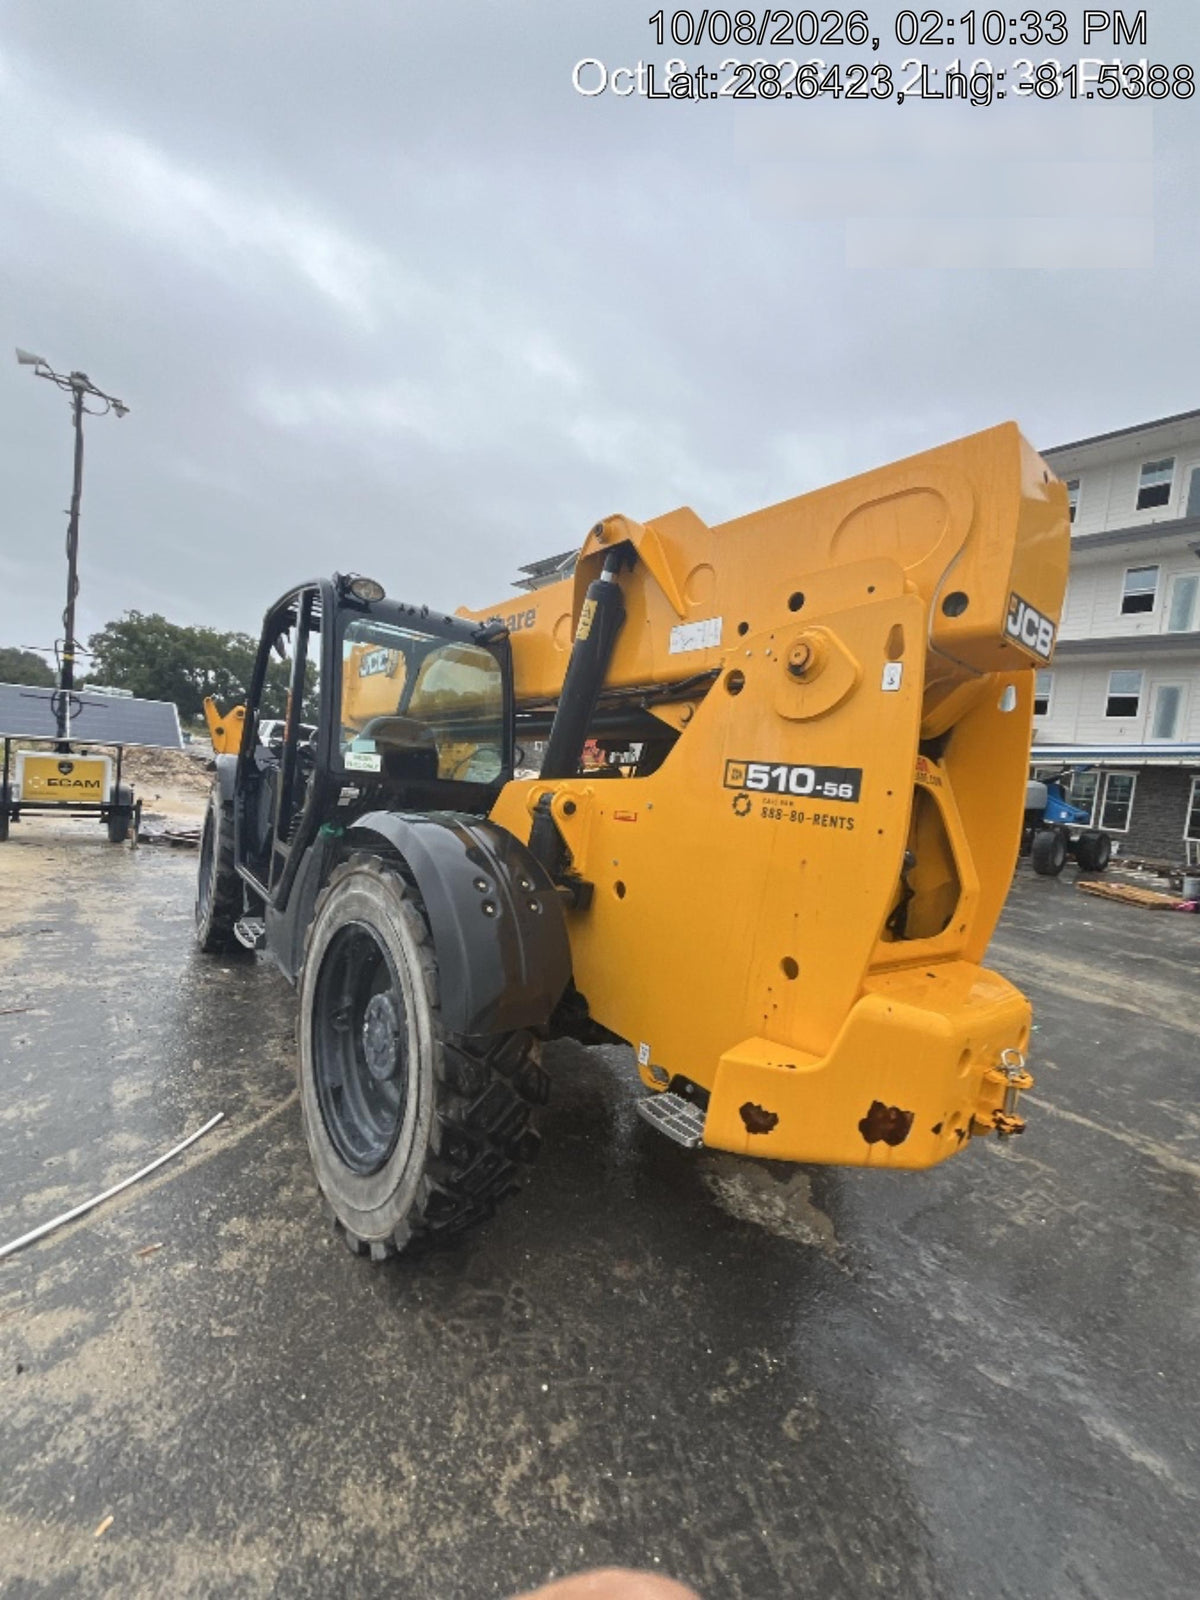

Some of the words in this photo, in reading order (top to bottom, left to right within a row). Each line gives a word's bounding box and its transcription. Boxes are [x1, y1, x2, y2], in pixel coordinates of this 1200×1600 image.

[1007, 602, 1053, 657] JCB
[47, 778, 100, 788] ECAM
[760, 806, 855, 831] 888-80-RENTS
